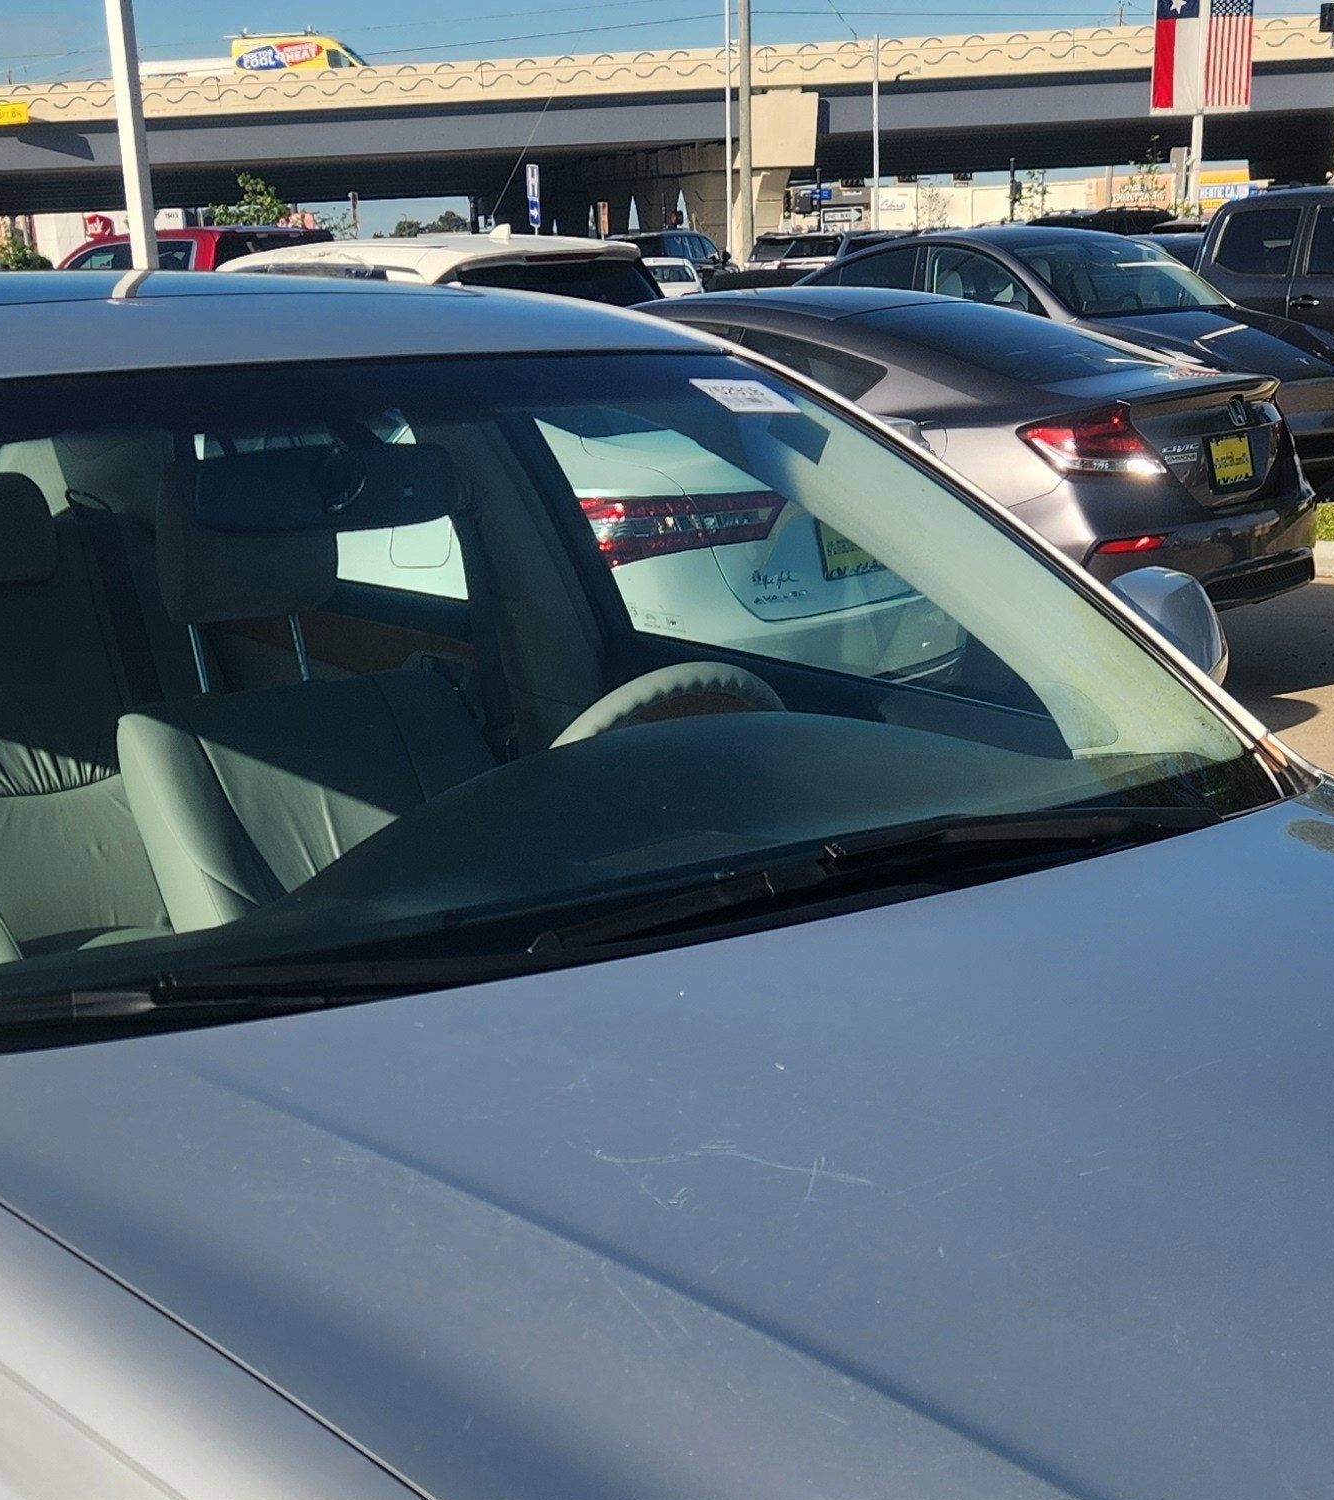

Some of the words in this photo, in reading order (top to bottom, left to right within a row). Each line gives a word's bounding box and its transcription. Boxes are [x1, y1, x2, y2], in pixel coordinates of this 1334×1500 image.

[243, 49, 274, 60] DOCTOR
[285, 48, 318, 63] HEAT
[243, 55, 276, 69] COOL
[528, 166, 538, 197] H
[1161, 443, 1199, 454] CIVIC
